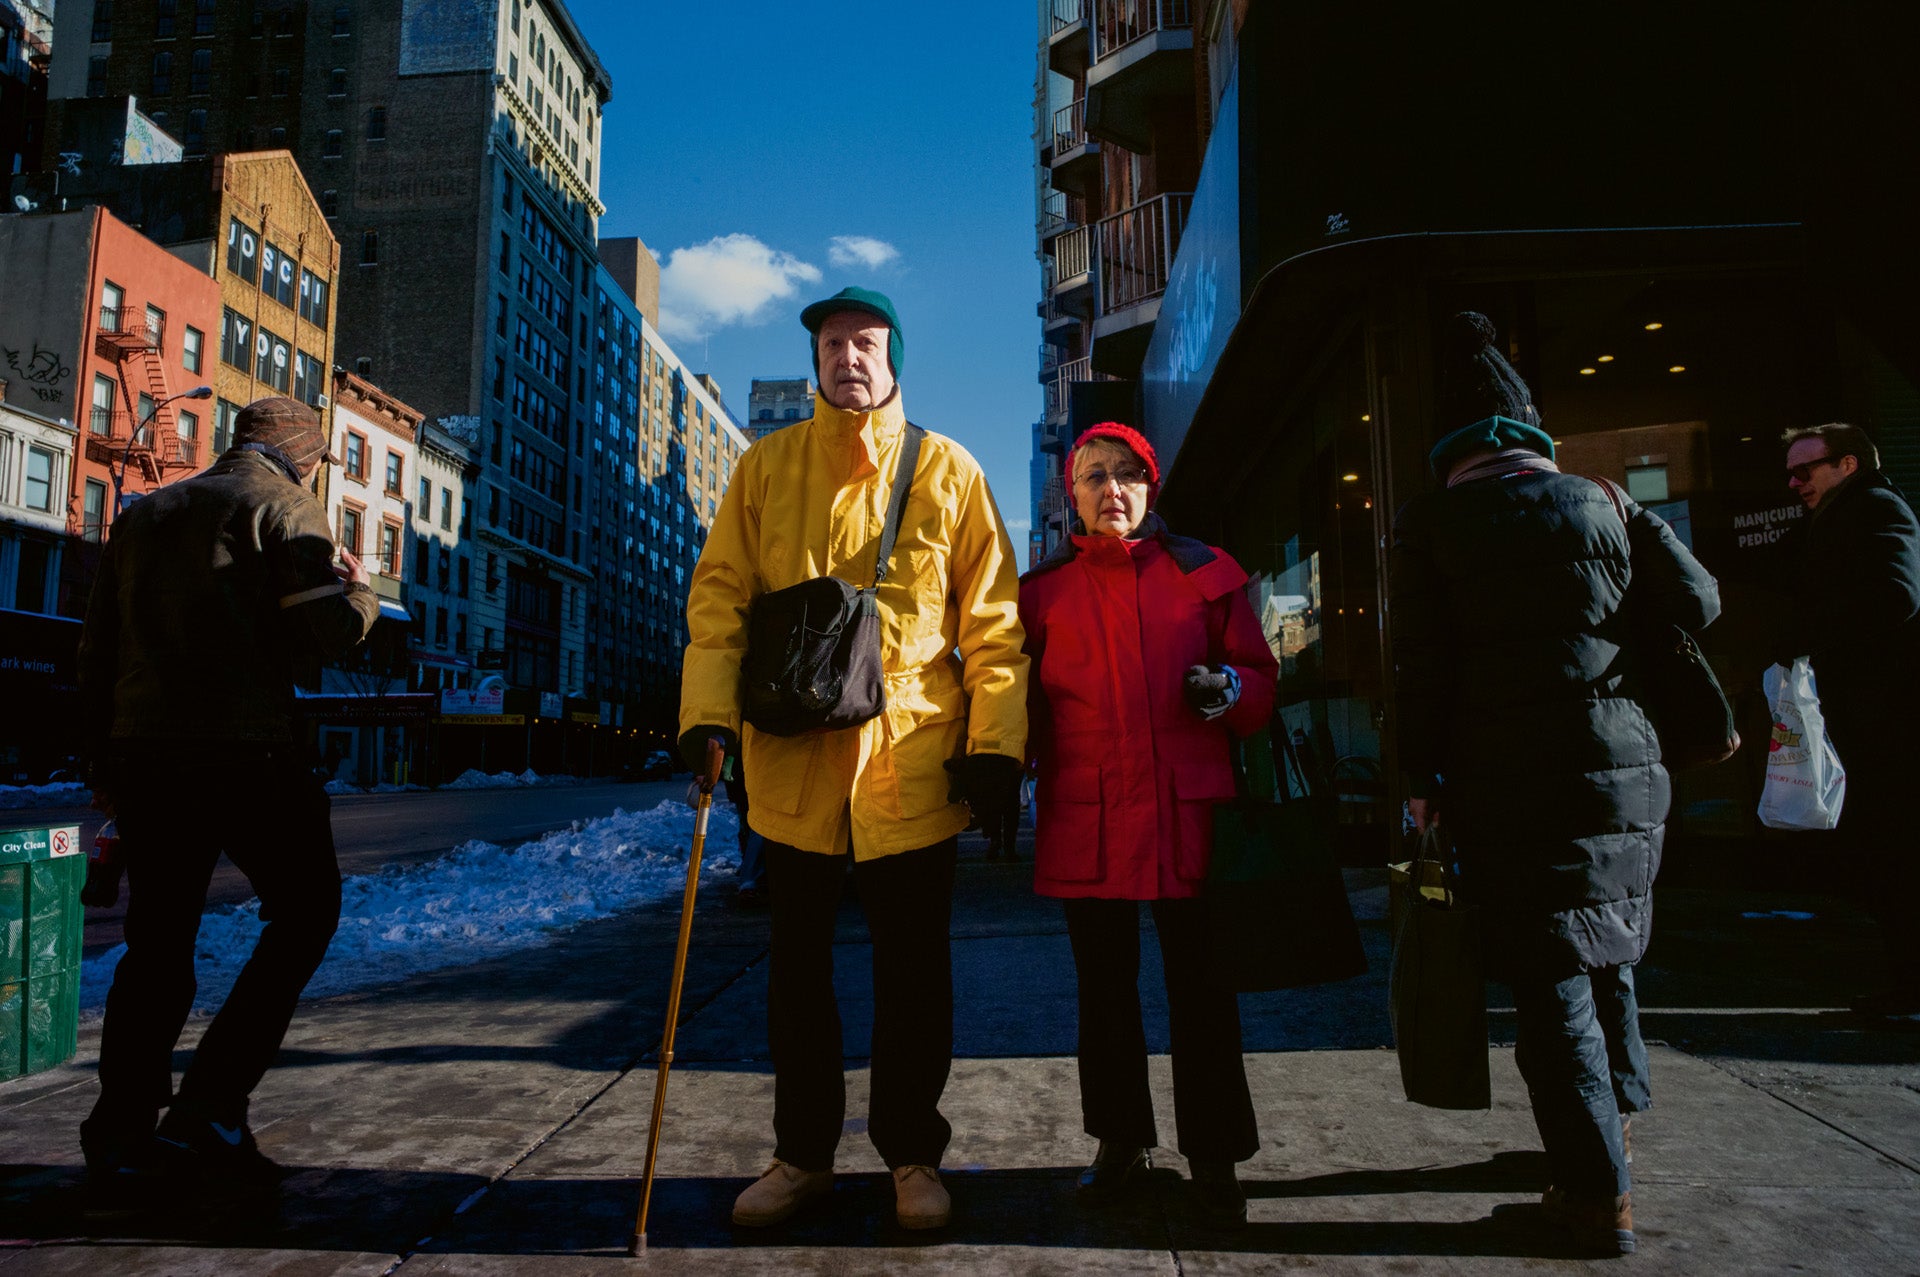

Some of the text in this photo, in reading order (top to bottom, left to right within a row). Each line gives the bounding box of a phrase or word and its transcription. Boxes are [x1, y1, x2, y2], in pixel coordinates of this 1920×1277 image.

[228, 223, 323, 305] JOSCHI
[236, 319, 304, 379] YOGA
[1733, 504, 1804, 529] MANICURE
[22, 658, 56, 675] wines
[2, 841, 46, 853] City Clean
